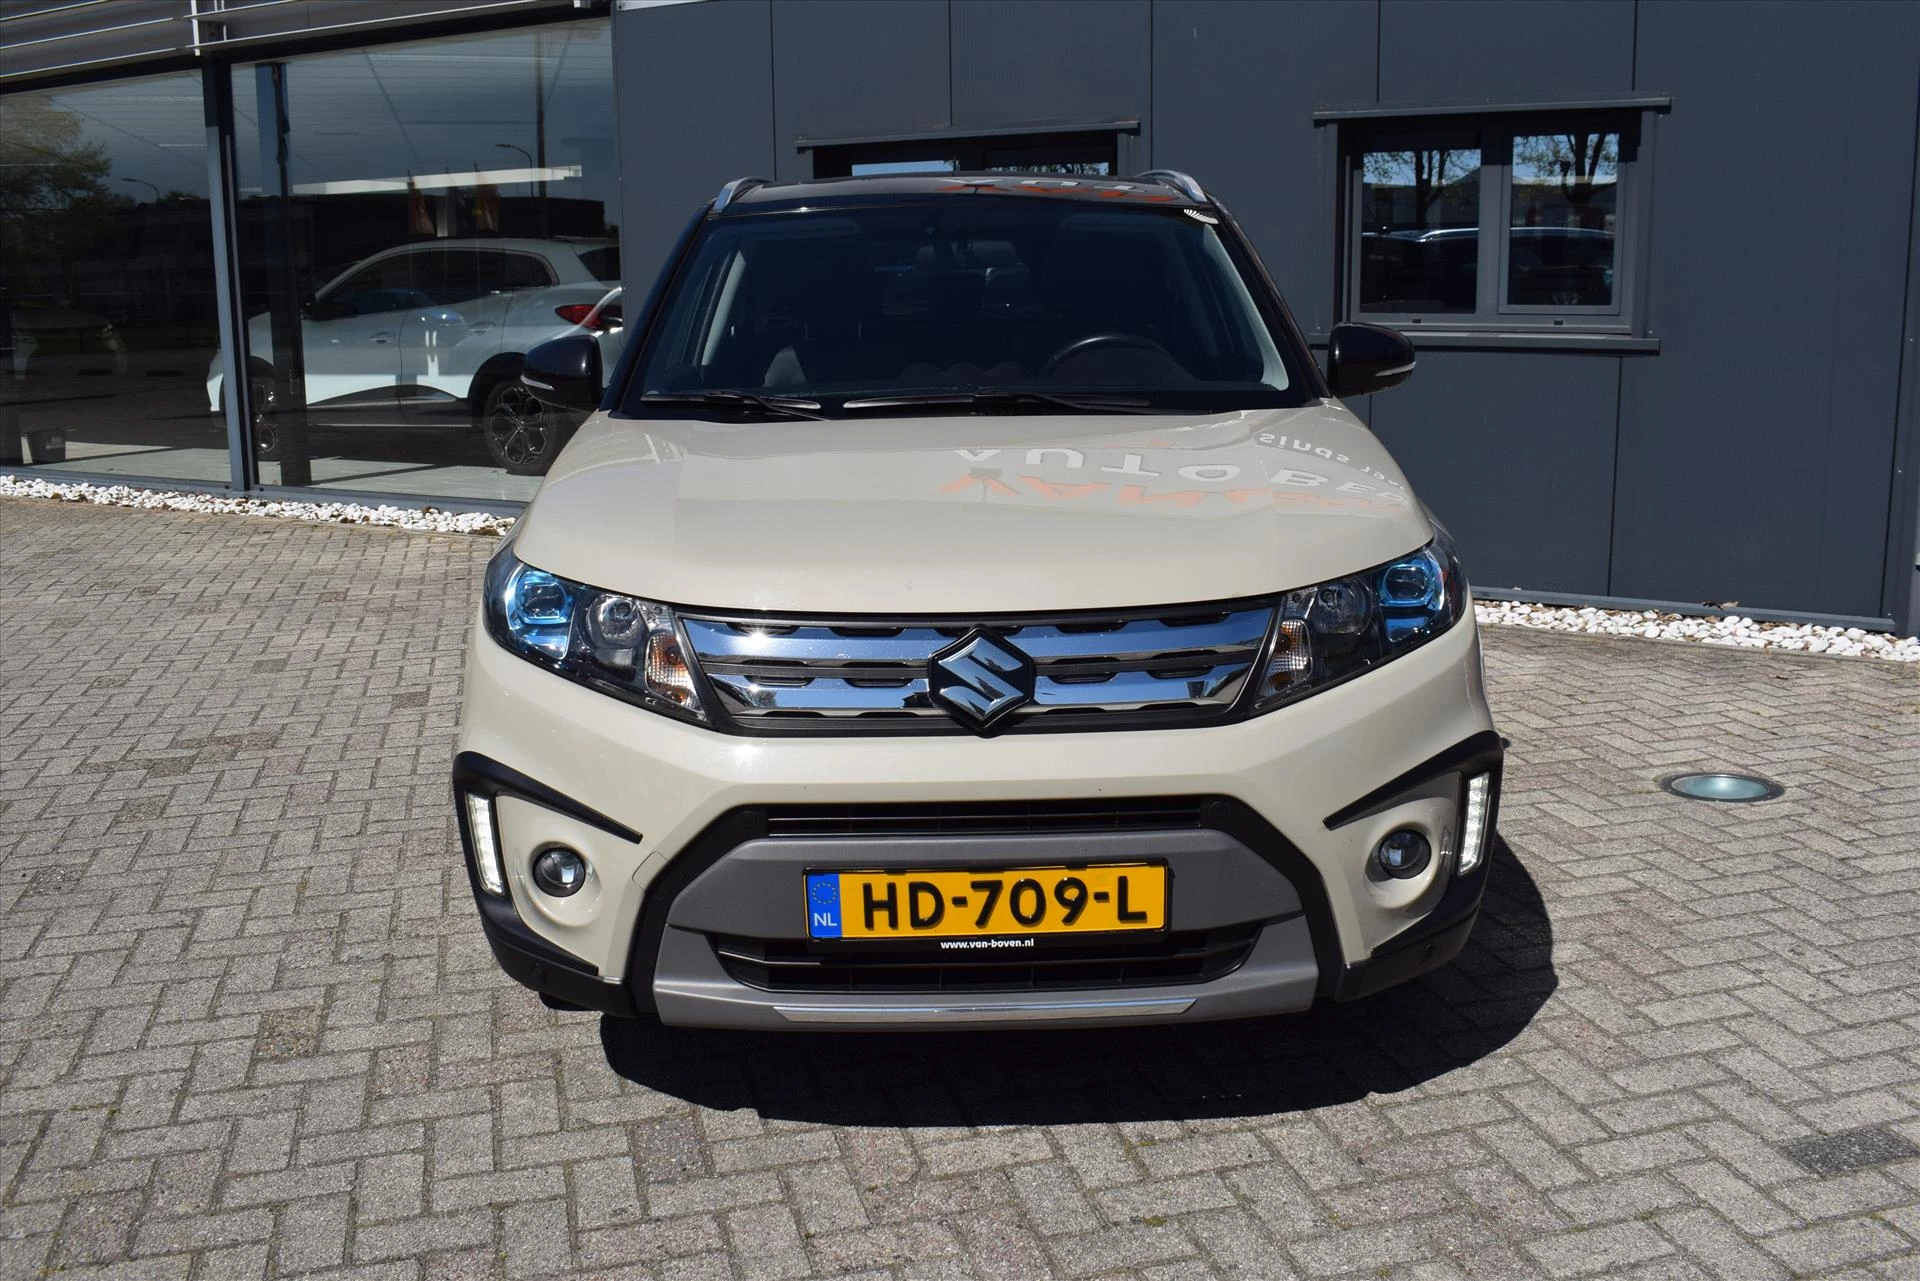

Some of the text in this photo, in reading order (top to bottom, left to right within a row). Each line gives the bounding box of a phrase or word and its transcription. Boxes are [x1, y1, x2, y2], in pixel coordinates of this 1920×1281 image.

[862, 876, 1147, 929] HD-709-L
[813, 912, 838, 927] NL
[940, 938, 1034, 950] www.van-boven.nl
